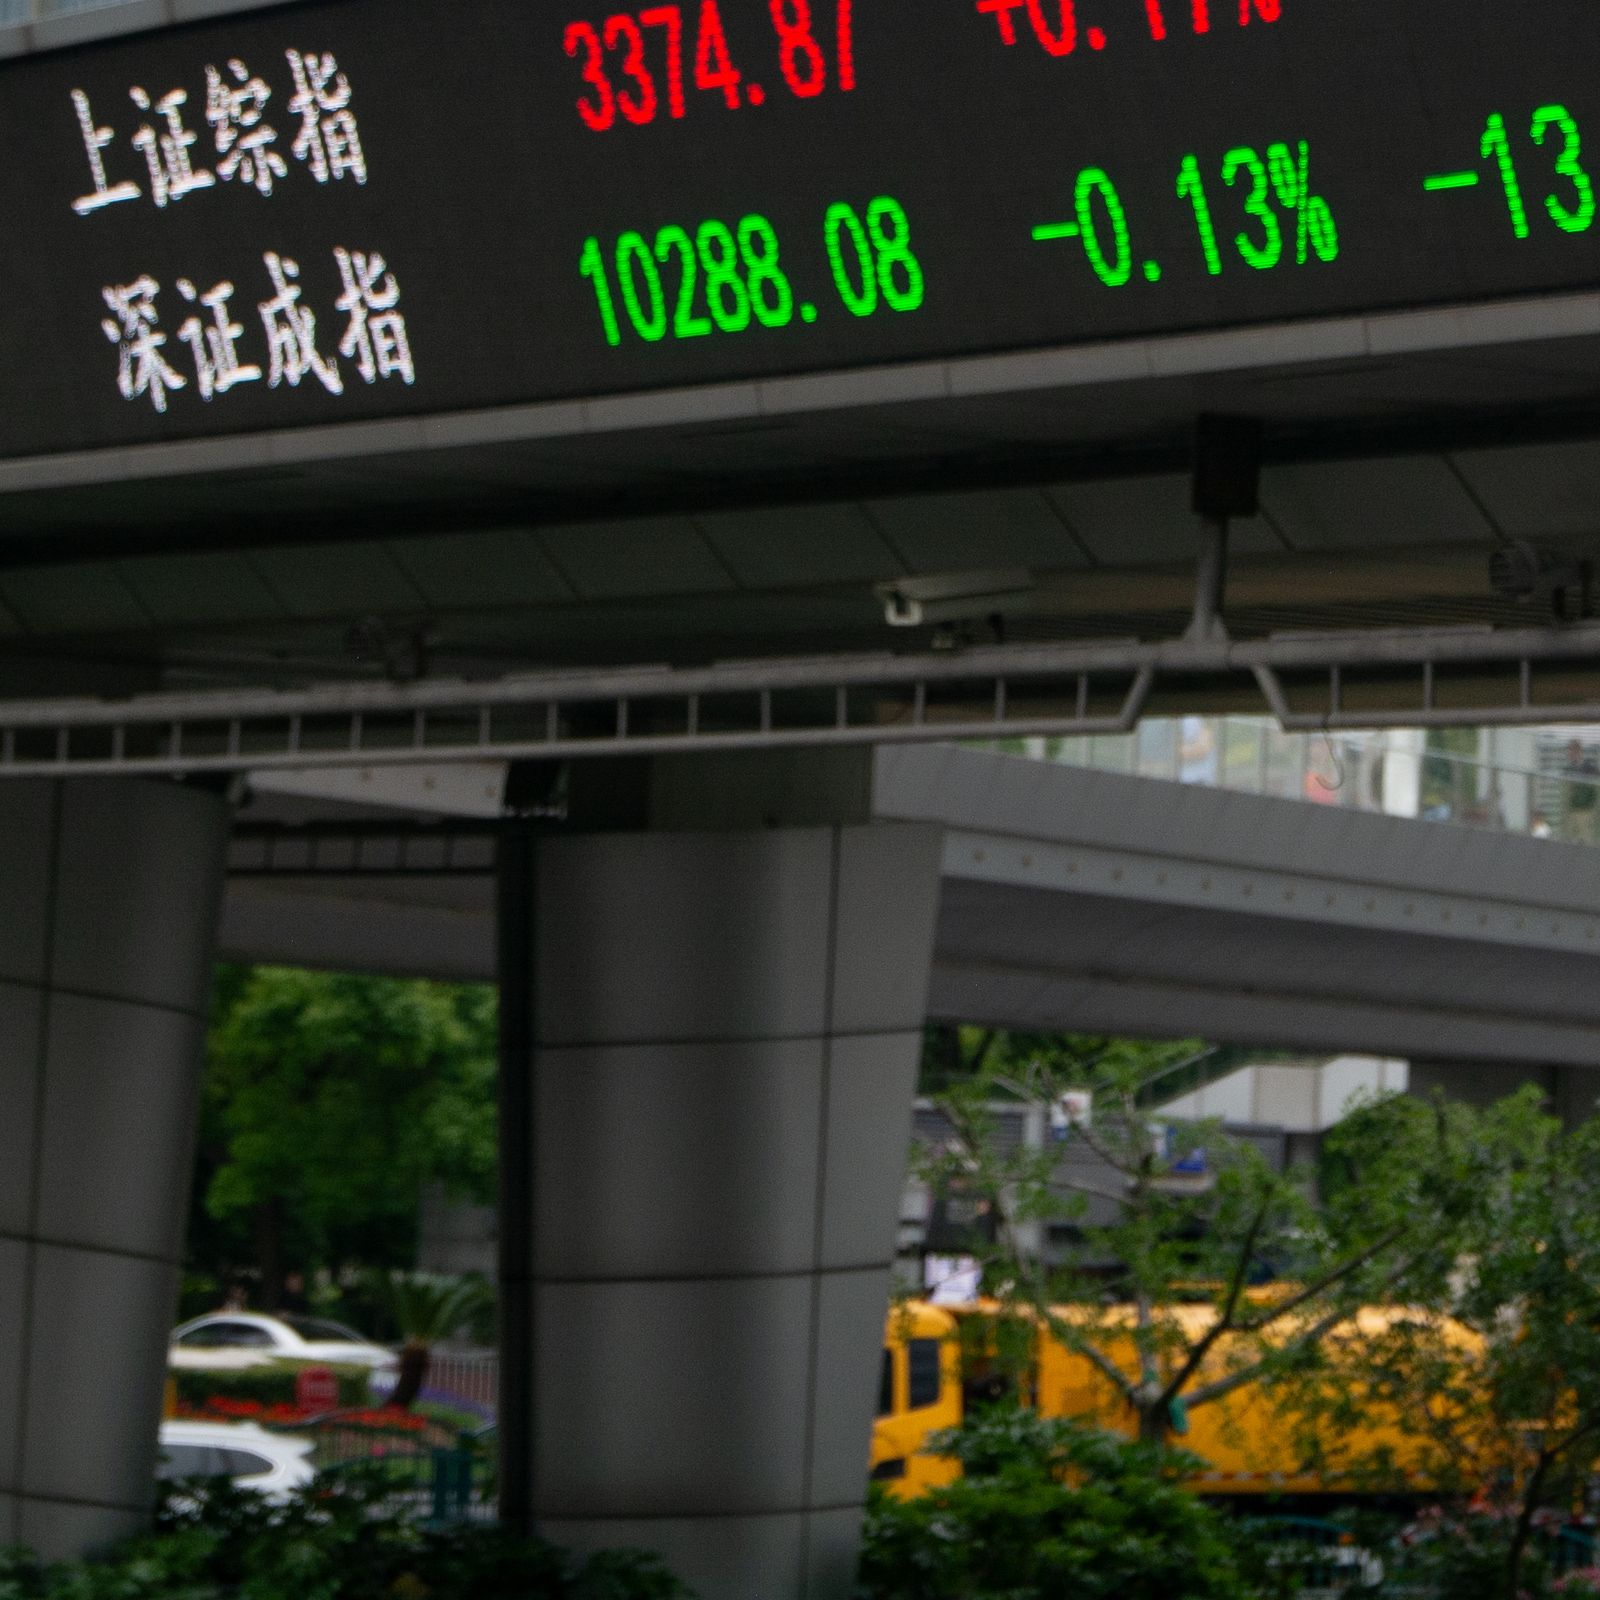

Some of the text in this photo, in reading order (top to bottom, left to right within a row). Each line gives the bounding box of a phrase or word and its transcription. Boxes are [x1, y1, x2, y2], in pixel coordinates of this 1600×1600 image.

[71, 48, 368, 216] 上证综指
[101, 246, 415, 413] 深证成指
[579, 195, 925, 347] 10288.08
[1031, 140, 1340, 288] -0.13%
